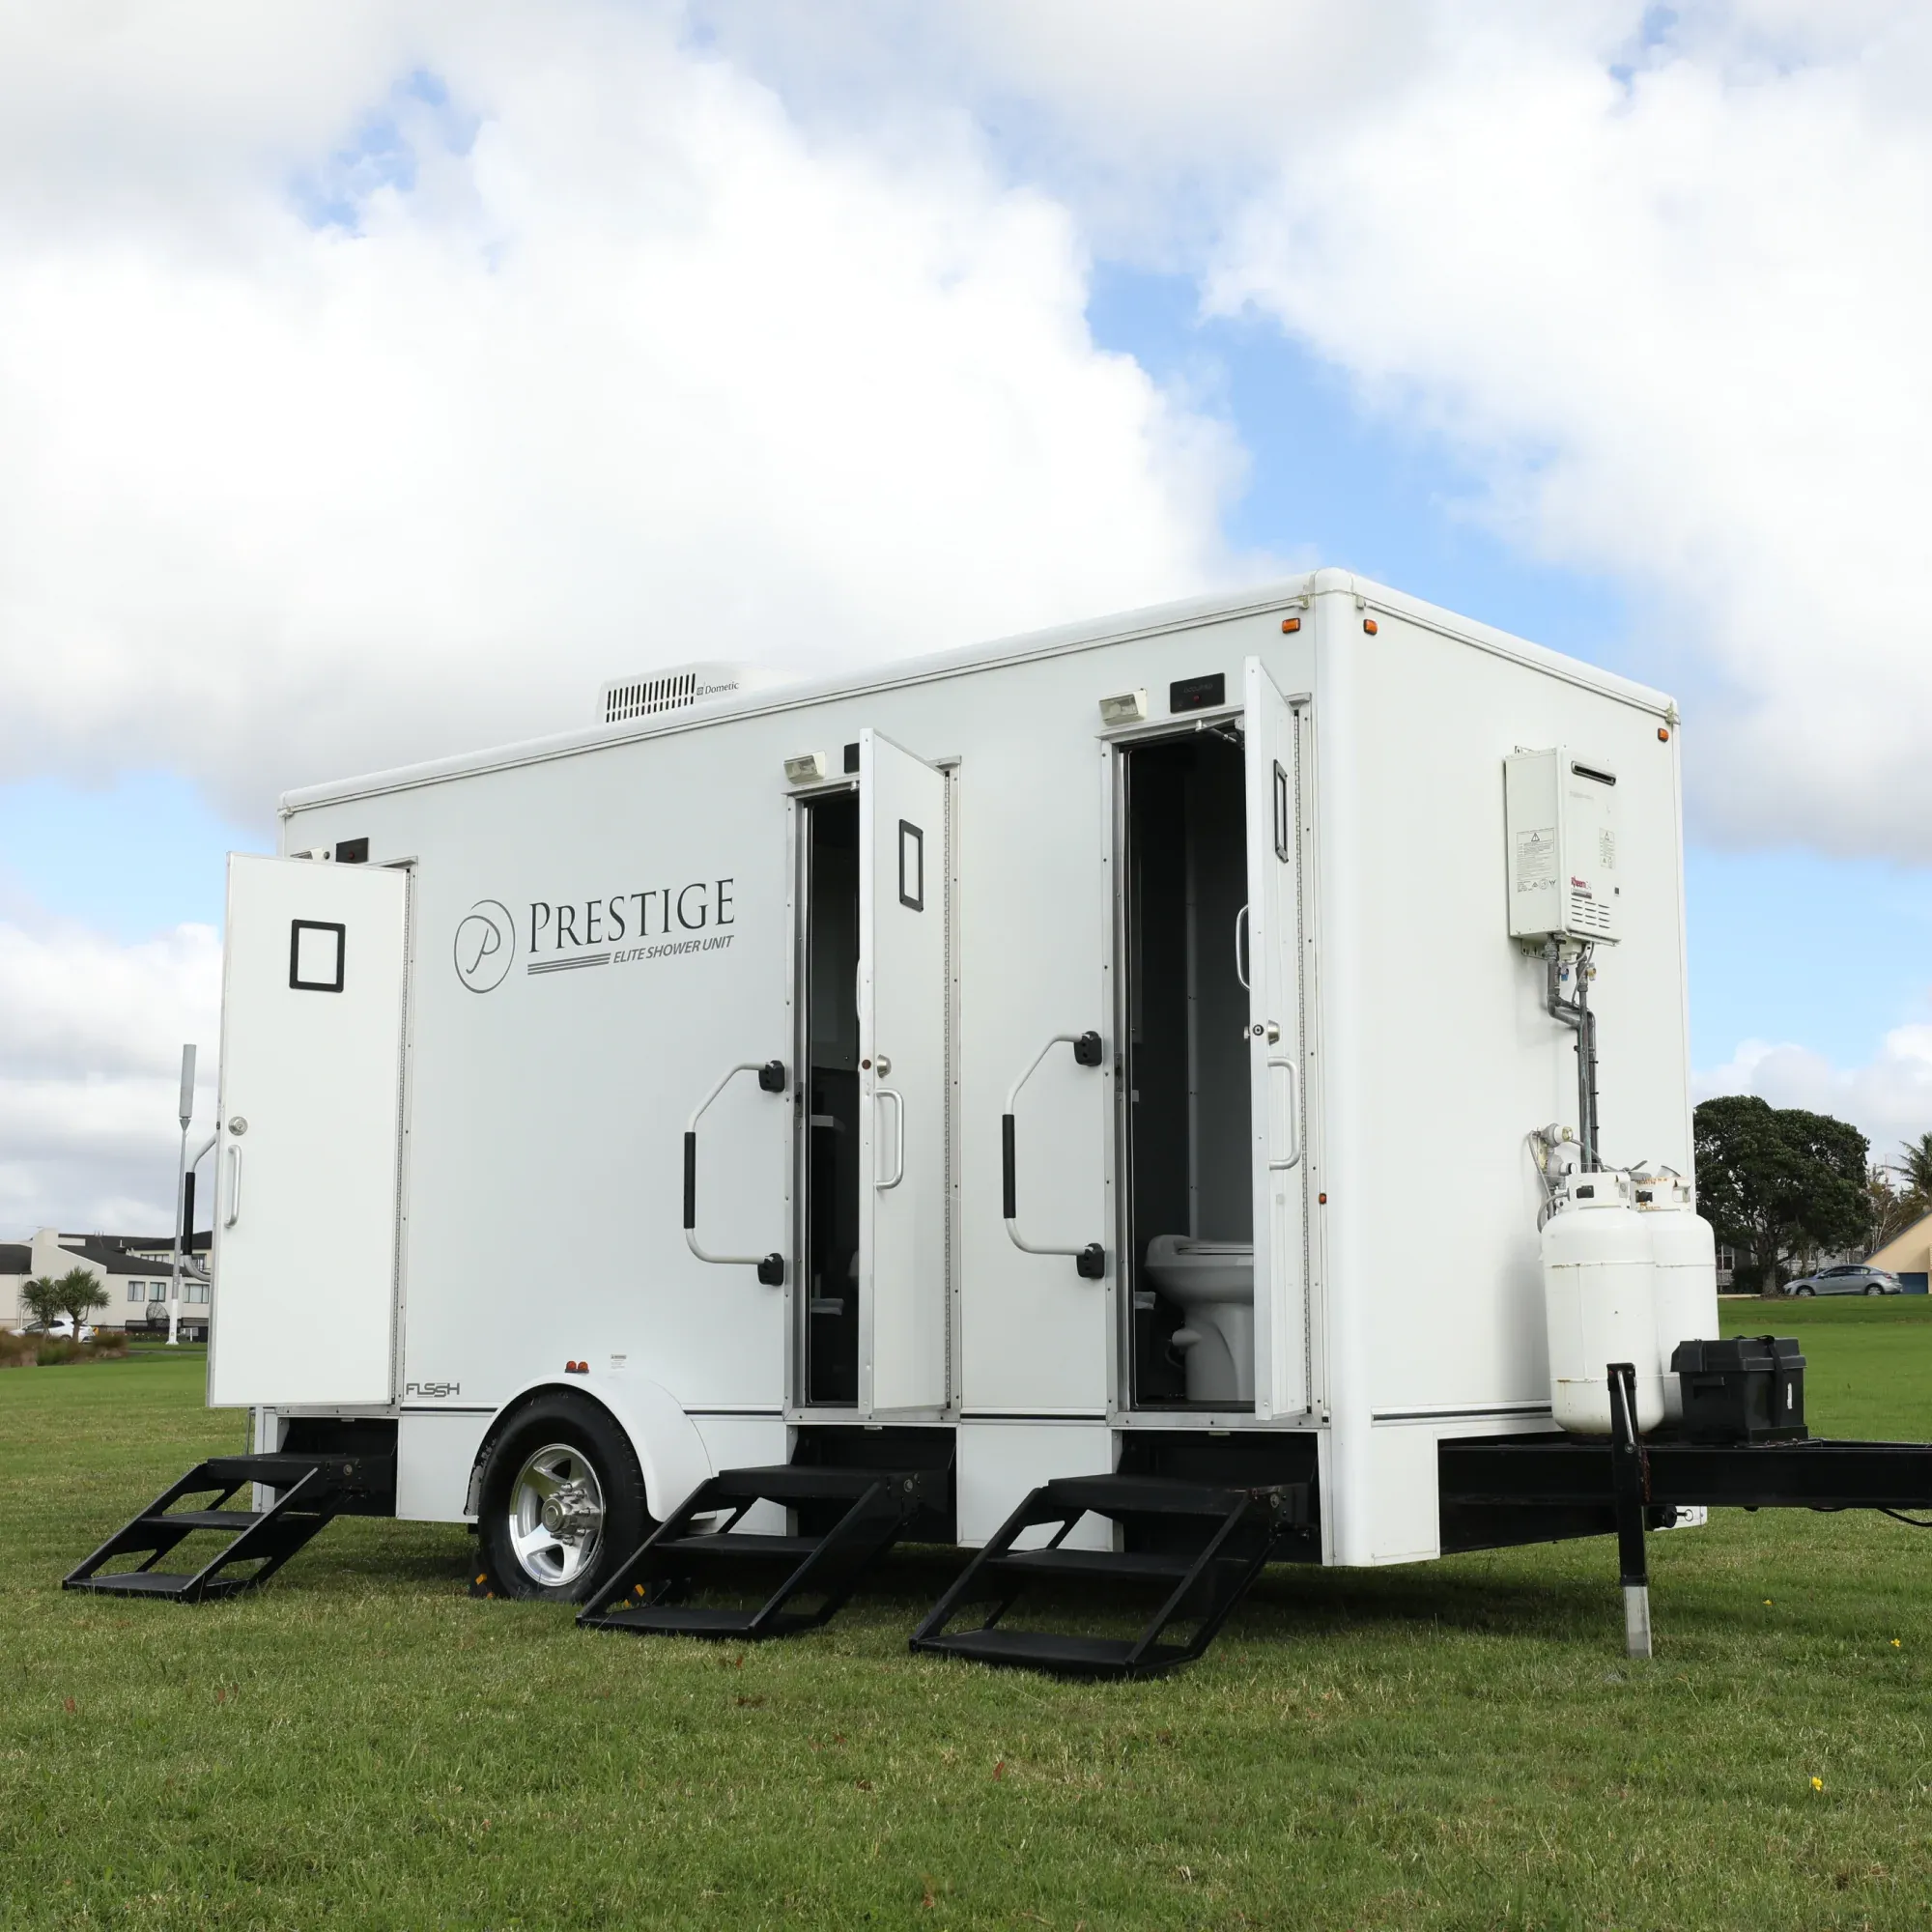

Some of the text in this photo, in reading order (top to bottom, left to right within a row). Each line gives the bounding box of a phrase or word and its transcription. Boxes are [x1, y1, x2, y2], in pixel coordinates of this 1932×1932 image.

[705, 681, 739, 695] Dometic
[528, 877, 735, 953] PRESTIGE
[613, 934, 735, 964] ELITE SHOWER UNIT
